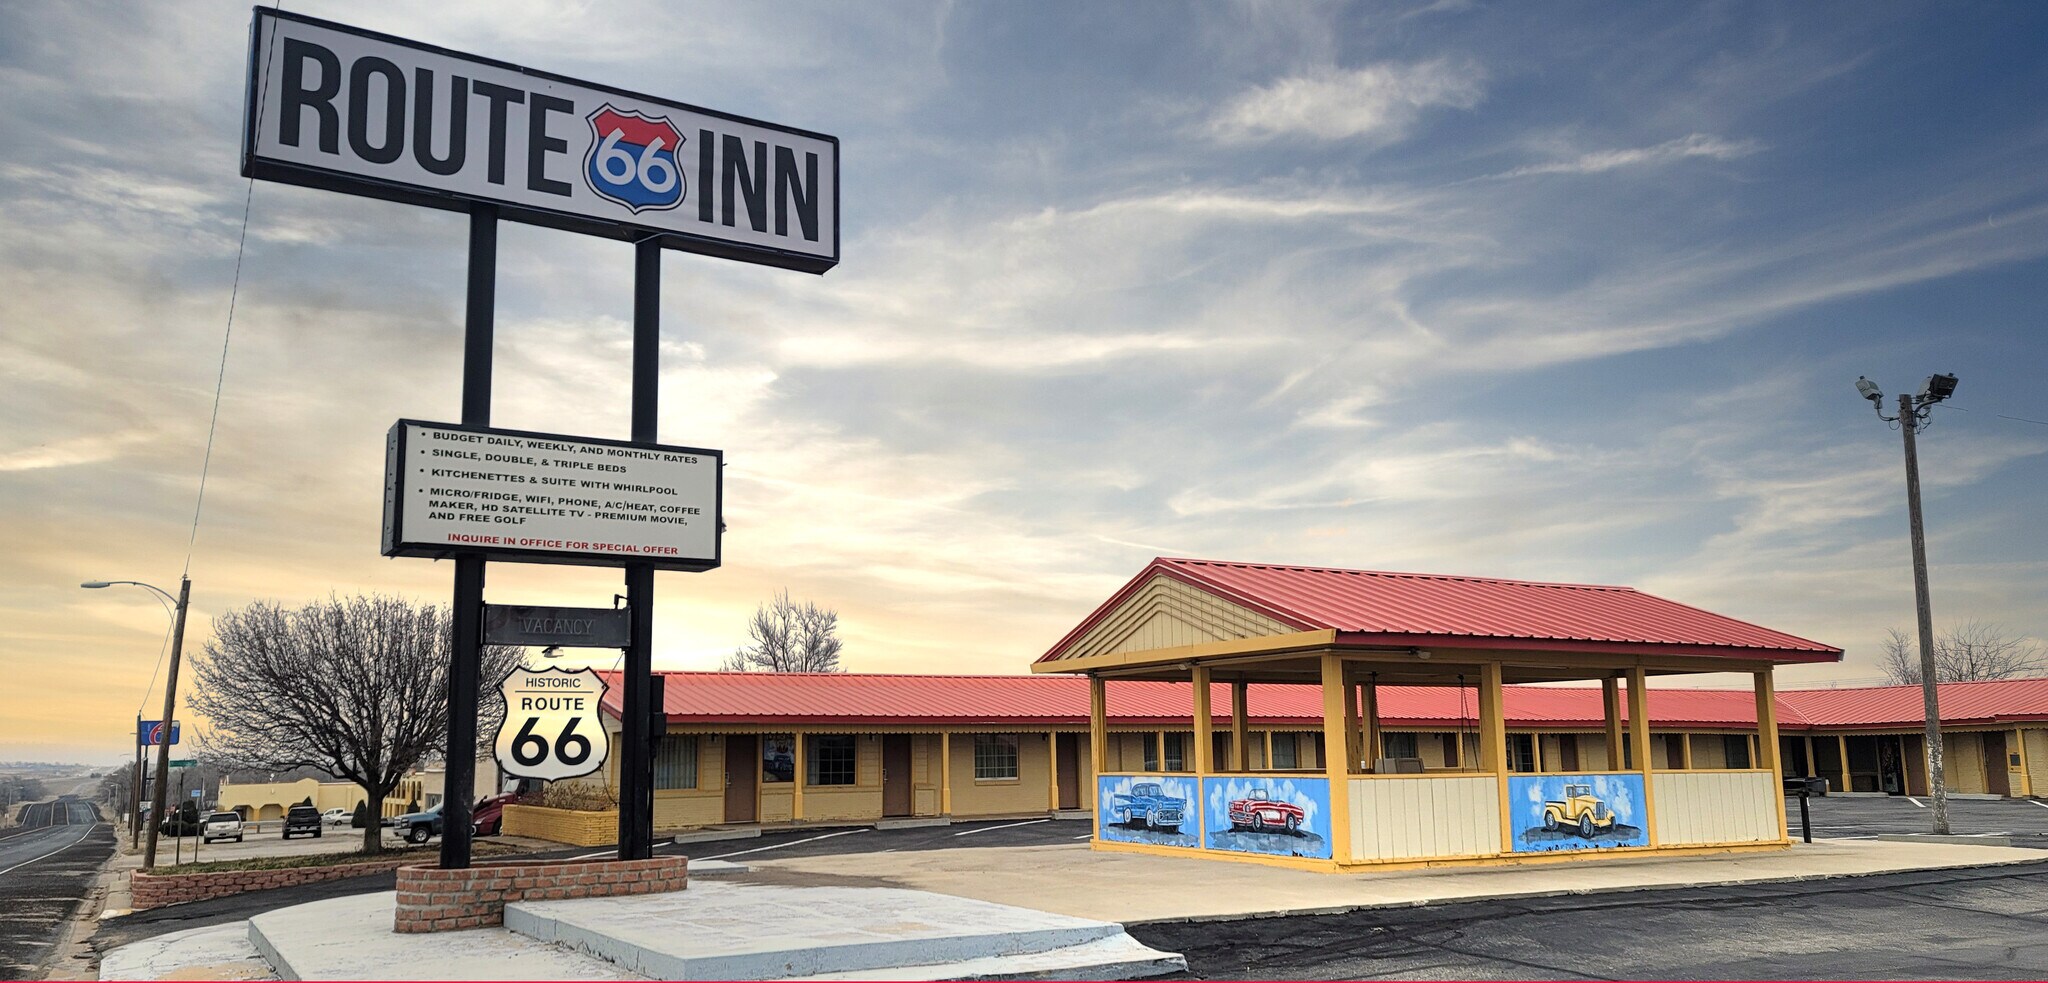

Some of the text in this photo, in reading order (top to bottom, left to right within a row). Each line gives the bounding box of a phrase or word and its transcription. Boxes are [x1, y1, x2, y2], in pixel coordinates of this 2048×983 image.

[278, 37, 818, 242] ROUTE 66 INN
[433, 432, 698, 464] BUDGET DAILY, WEEKLY, AND MONTHLY RATES
[432, 449, 481, 462] SINGLE,
[485, 454, 537, 466] DOUBLE,
[553, 460, 594, 470] TRIPLE
[597, 464, 627, 473] BEDS
[431, 469, 525, 482] KITCHENETTES
[541, 477, 576, 487] SUITE
[580, 480, 610, 490] WITH
[613, 484, 678, 495] WHIRLPOOL
[428, 501, 478, 512] MAKER,
[502, 506, 566, 516] SATELLITE
[595, 512, 647, 522] PREMIUM
[650, 516, 688, 526] MOVIE,
[430, 488, 701, 515] MICRO/FRIDGE, WIFI, PHONE, A/C/HEAT, COFFEE
[428, 512, 527, 525] AND FREE GOLF
[448, 533, 500, 545] INQUIRE
[520, 538, 562, 548] OFFICE
[566, 541, 589, 550] FOR
[592, 543, 640, 552] SPECIAL
[643, 546, 678, 554] OFFER
[522, 618, 593, 634] VACANCY
[525, 678, 581, 688] HISTORIC
[521, 698, 584, 710] ROUTE
[511, 717, 591, 766] 66
